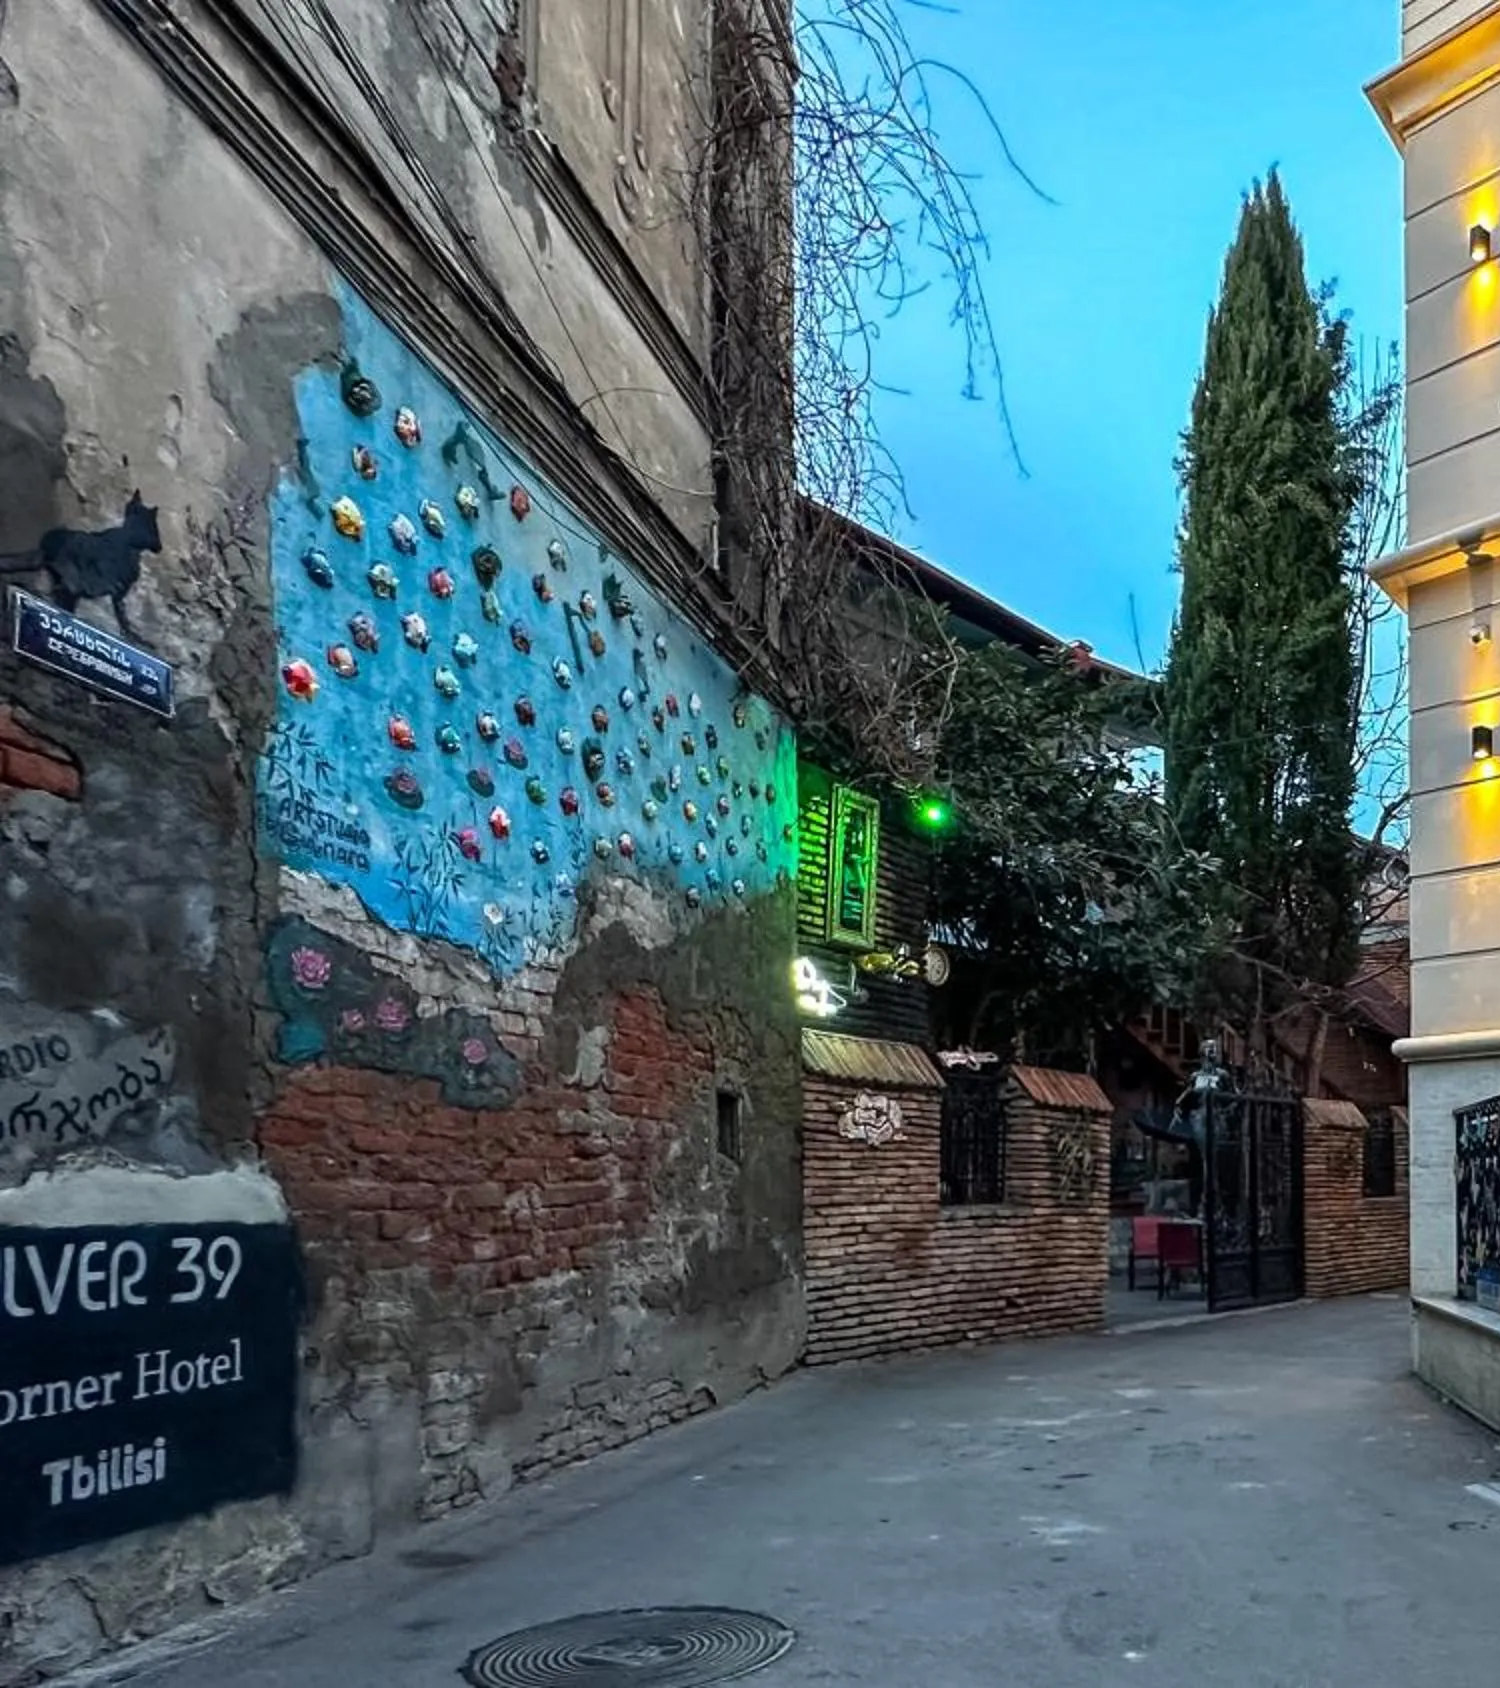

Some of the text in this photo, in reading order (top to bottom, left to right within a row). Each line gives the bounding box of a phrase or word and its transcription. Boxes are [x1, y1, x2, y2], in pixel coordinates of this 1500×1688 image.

[0, 1056, 161, 1142] რჯობა
[0, 1236, 243, 1317] LVER 39
[132, 1337, 244, 1400] Hotel
[42, 1436, 166, 1505] Tbilisi
